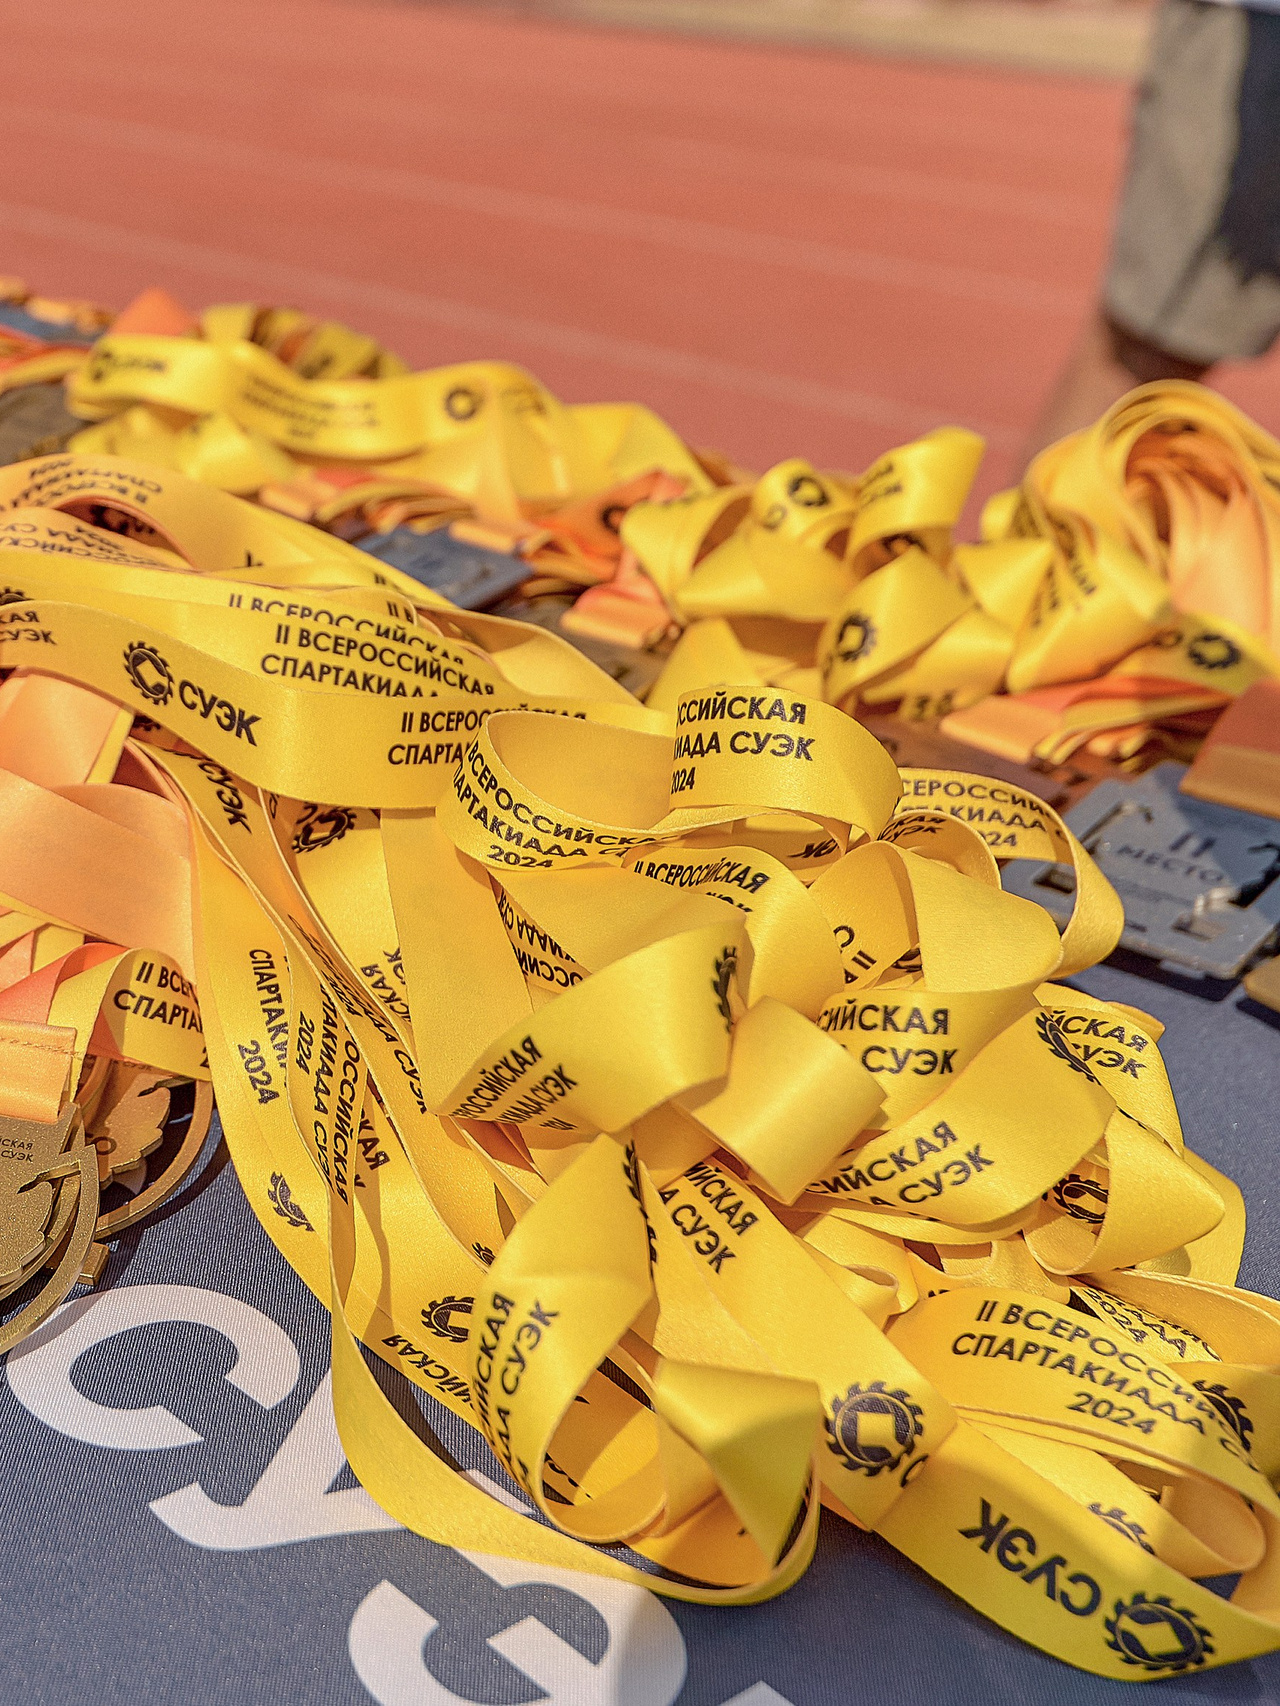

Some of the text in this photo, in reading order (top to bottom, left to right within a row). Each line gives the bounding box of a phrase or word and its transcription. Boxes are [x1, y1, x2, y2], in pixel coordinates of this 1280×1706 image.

[274, 624, 496, 696] II ВСЕРОССИЙСКАЯ
[178, 681, 262, 747] СУЭК
[401, 711, 416, 733] II
[729, 730, 816, 762] СУЭК
[197, 761, 253, 835] СУЭК
[486, 844, 554, 869] 2024
[136, 961, 154, 984] II
[238, 1039, 281, 1106] 2024
[296, 1010, 316, 1076] 2024
[861, 1045, 958, 1076] СУЭК
[529, 1063, 578, 1104] СУЭК
[0, 1149, 34, 1162] СУЭК
[898, 1142, 995, 1204] СУЭК
[671, 1203, 737, 1275] СУЭК
[975, 1300, 999, 1323] II
[1082, 1287, 1149, 1344] 2024
[501, 1299, 560, 1397] СУЭК
[951, 1333, 1206, 1436] СПАРТАКИАДА
[1067, 1390, 1158, 1436] 2024
[6, 1283, 804, 1706] СУЭ
[958, 1496, 1102, 1617] СУЭК
